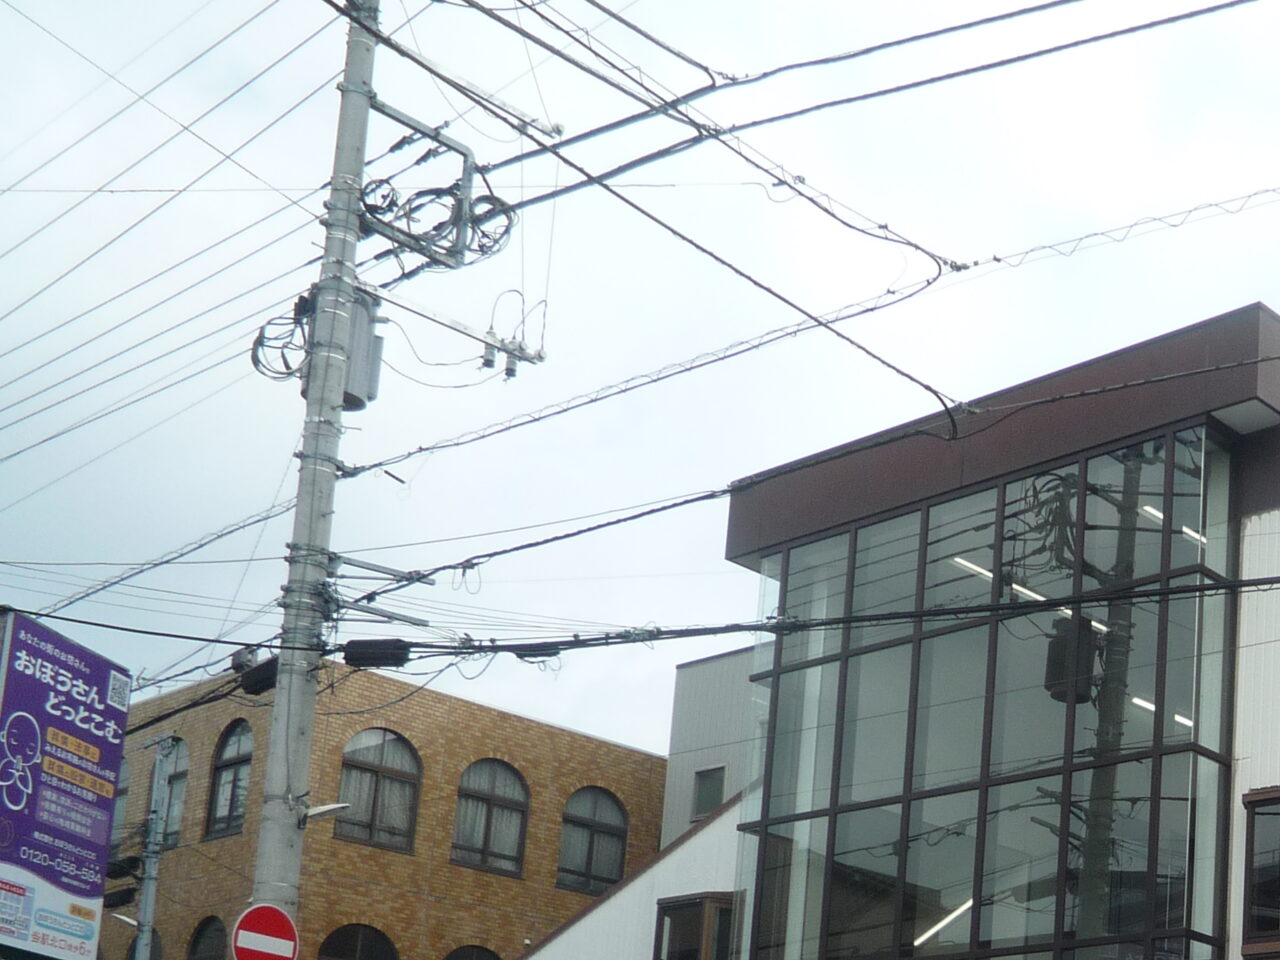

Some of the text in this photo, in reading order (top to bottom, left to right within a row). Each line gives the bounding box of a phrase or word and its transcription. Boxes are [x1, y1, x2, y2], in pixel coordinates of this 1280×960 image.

[14, 650, 104, 710] おぼうさん
[45, 691, 122, 744] どっとこむ
